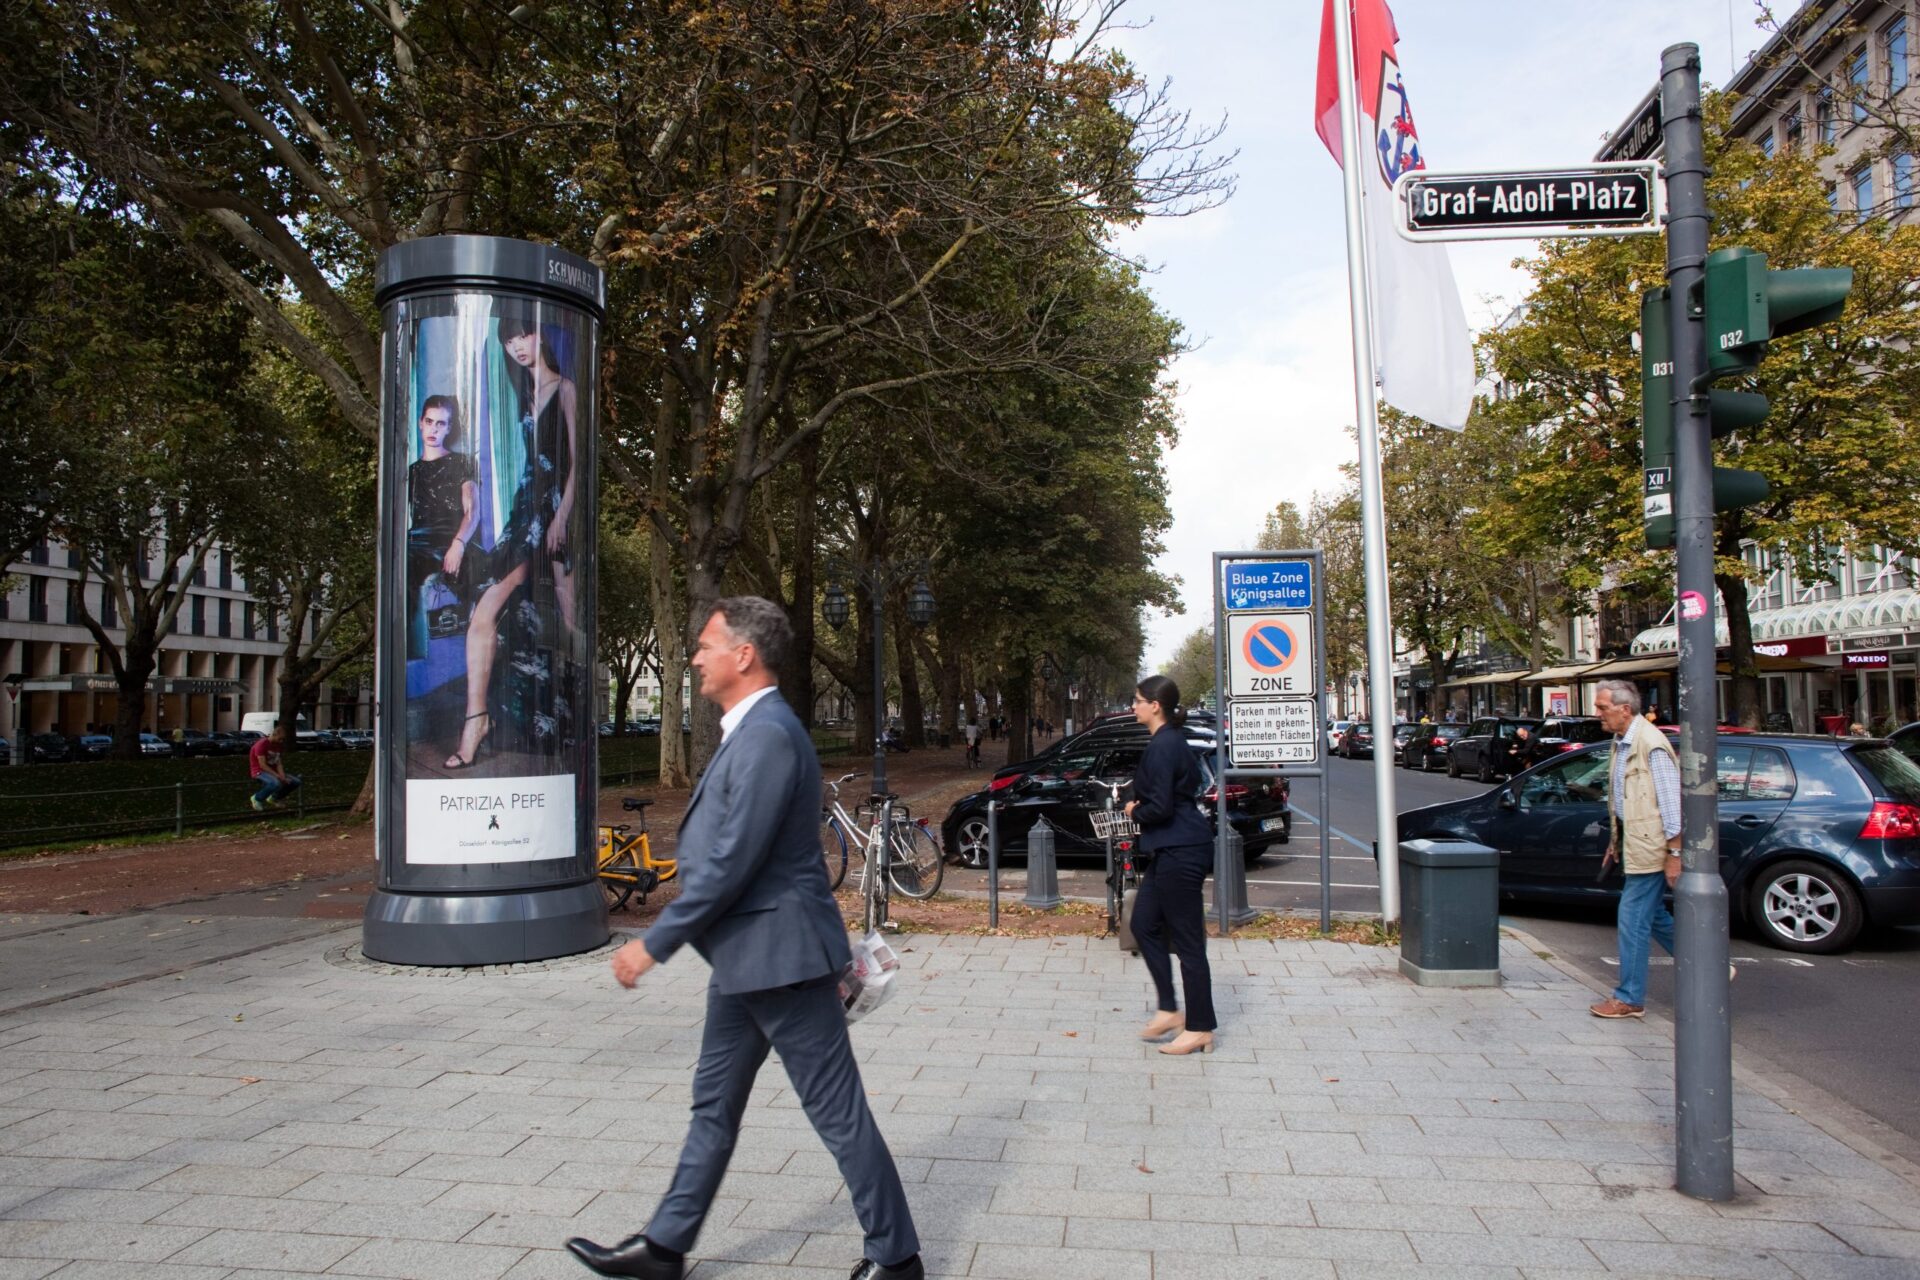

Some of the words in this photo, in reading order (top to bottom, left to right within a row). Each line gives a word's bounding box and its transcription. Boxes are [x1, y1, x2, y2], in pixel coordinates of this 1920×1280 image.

[1423, 181, 1637, 217] Graf-Adolf-Platz
[1720, 329, 1743, 349] 032
[1652, 362, 1674, 376] 031
[1232, 573, 1268, 584] Blaue
[1272, 572, 1303, 584] Zone
[1231, 587, 1306, 602] Königsallee
[1847, 655, 1887, 663] MAREDO
[1251, 677, 1293, 691] ZONE
[1236, 706, 1264, 716] Parken
[1268, 706, 1281, 716] mit
[1285, 705, 1309, 715] Park-
[1235, 719, 1261, 728] schein
[1265, 718, 1272, 728] in
[1276, 718, 1310, 730] gekenn-
[1236, 731, 1277, 741] zeichneten
[1280, 730, 1311, 740] Flächen
[1237, 748, 1274, 760] werktags
[1278, 748, 1283, 757] 9
[1293, 747, 1303, 757] 20
[1306, 747, 1311, 757] h
[440, 795, 505, 811] PATRIZIA
[511, 793, 545, 809] PEPE
